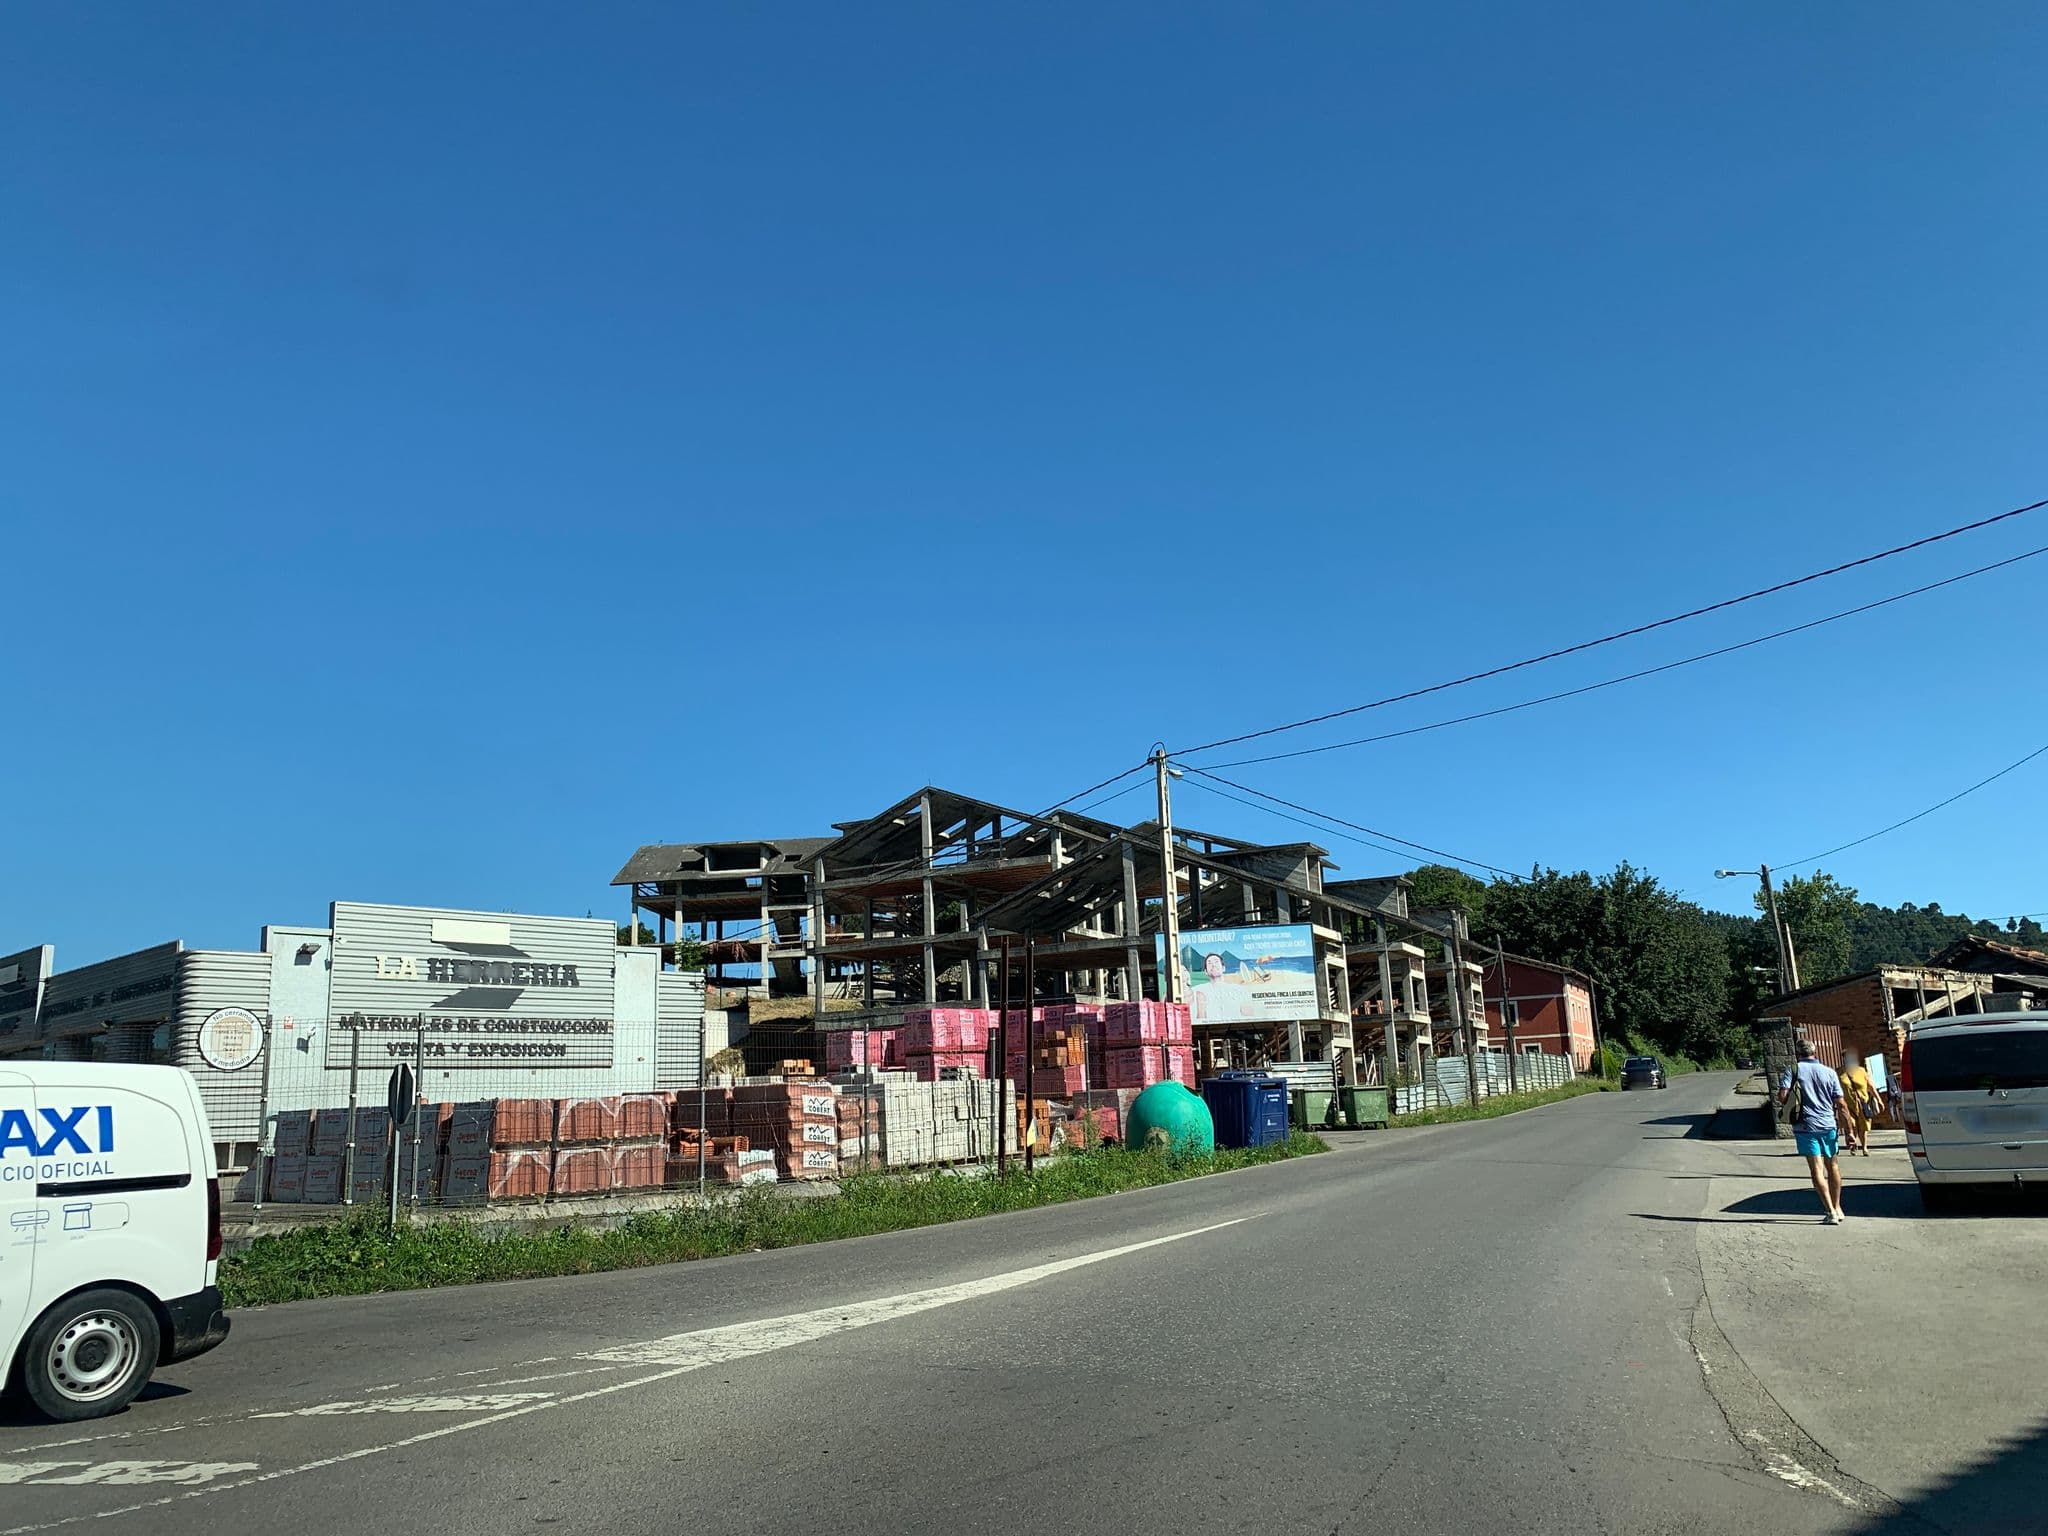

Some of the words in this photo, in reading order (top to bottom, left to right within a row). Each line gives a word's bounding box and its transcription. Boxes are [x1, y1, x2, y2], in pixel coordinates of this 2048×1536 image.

[376, 955, 418, 980] LA
[213, 1013, 223, 1022] No
[225, 1010, 255, 1024] cerramos
[457, 1019, 480, 1033] DE
[483, 1017, 609, 1034] CONSTRUCCIÓN
[386, 1042, 446, 1057] VENTA
[452, 1043, 463, 1055] Y
[467, 1040, 567, 1057] EXPOSICIÓN
[808, 1105, 830, 1113] COBERT
[0, 1106, 114, 1159] AXI
[2, 1166, 35, 1182] CIO
[41, 1160, 114, 1179] OFICIAL
